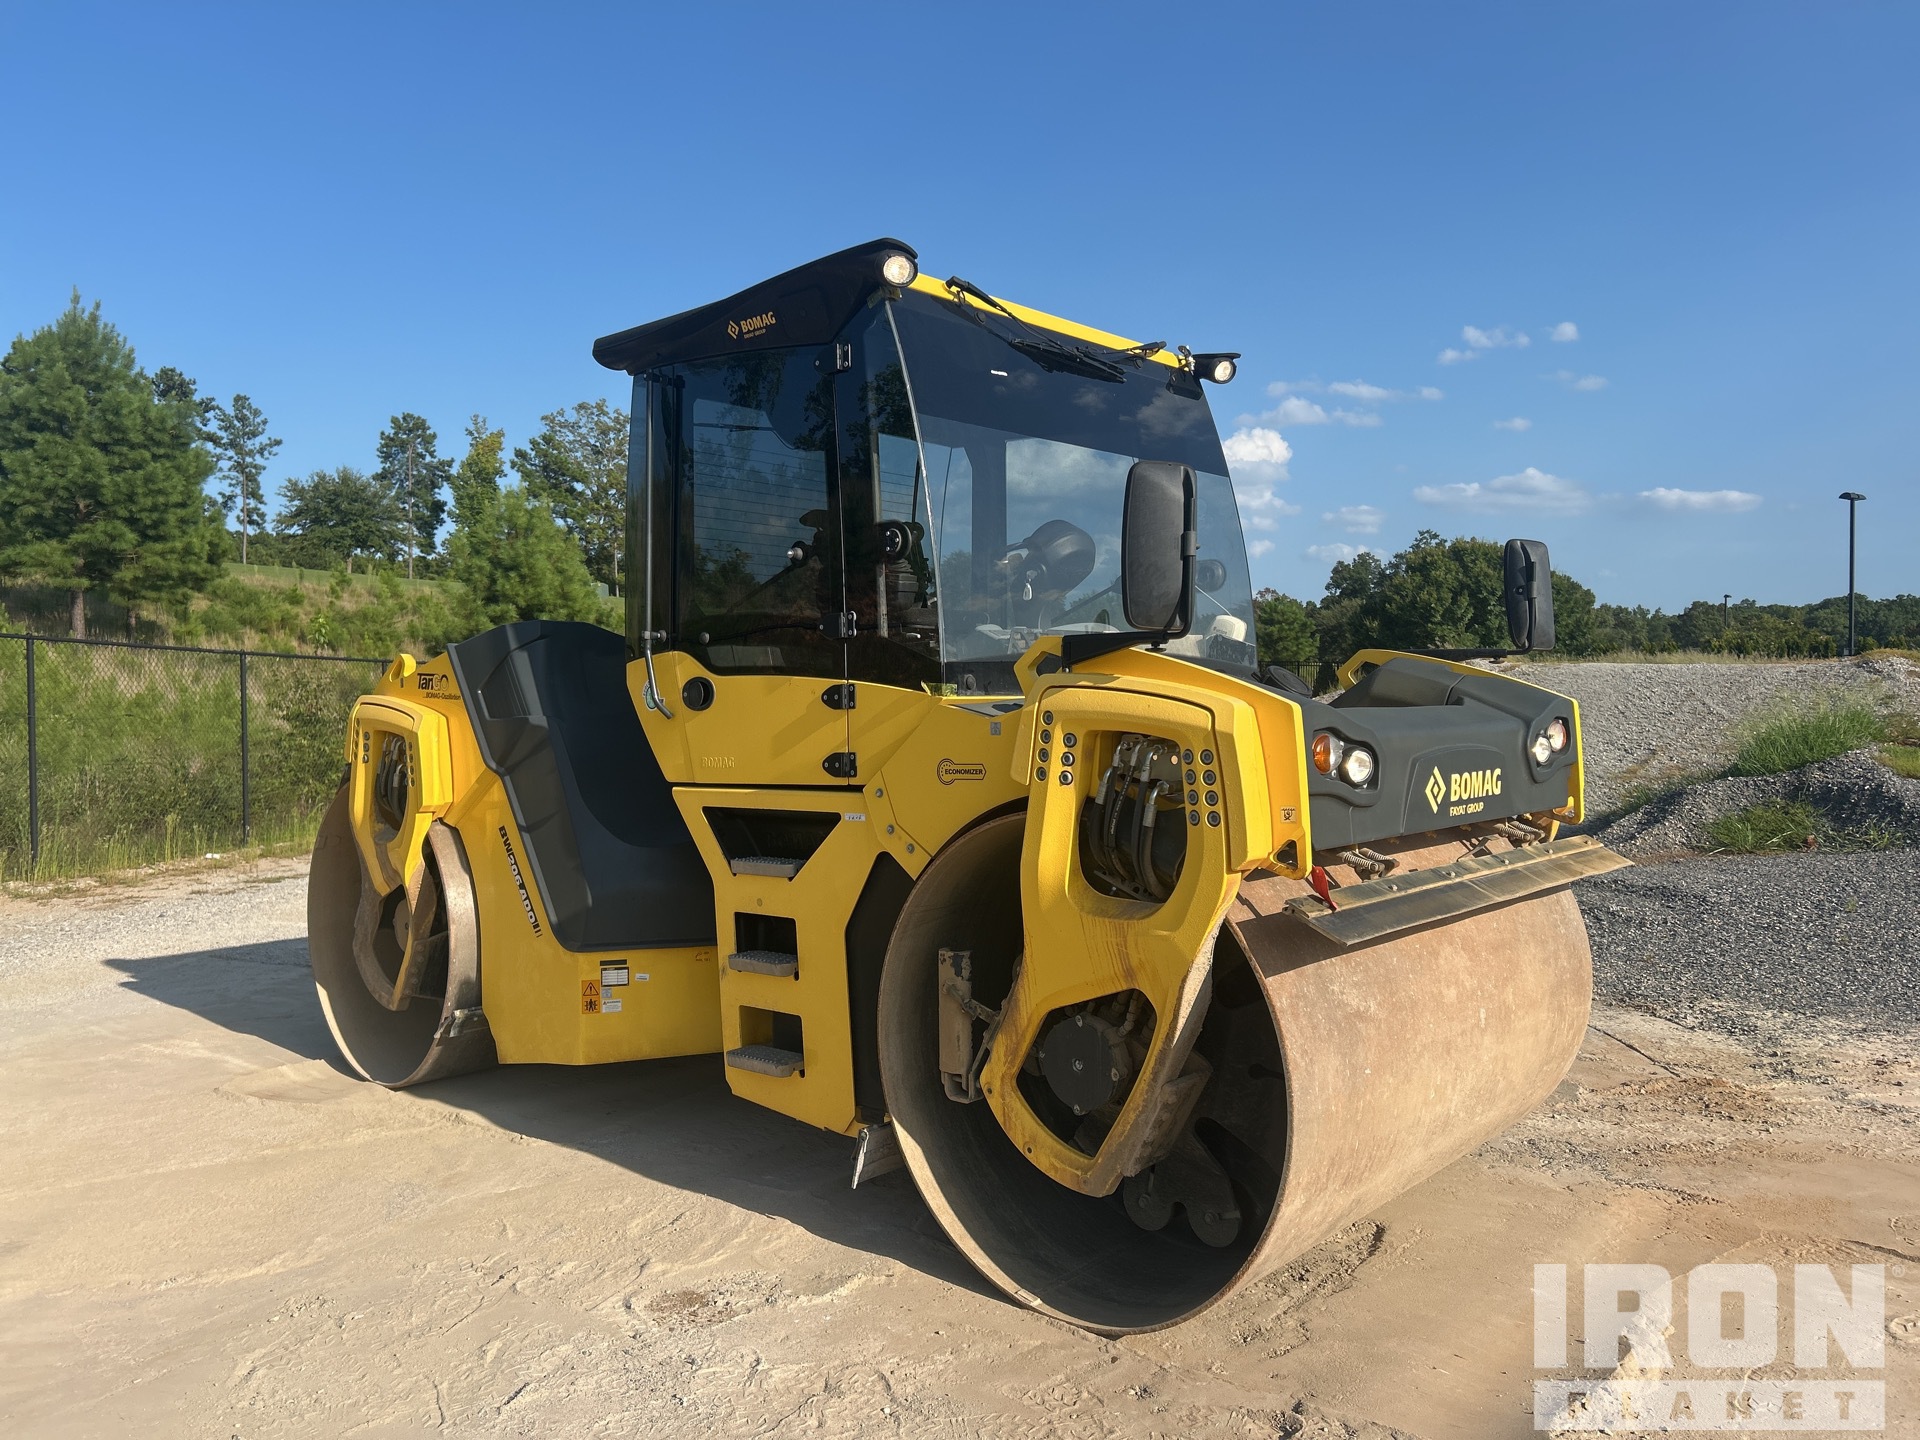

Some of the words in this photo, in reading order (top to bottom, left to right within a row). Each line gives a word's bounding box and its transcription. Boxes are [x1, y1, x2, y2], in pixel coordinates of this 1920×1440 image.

[740, 312, 776, 332] BOMAG
[702, 756, 735, 768] BOMAG
[1450, 768, 1502, 801] BOMAG
[1450, 805, 1466, 816] FAYAT
[1466, 802, 1484, 814] GROUP
